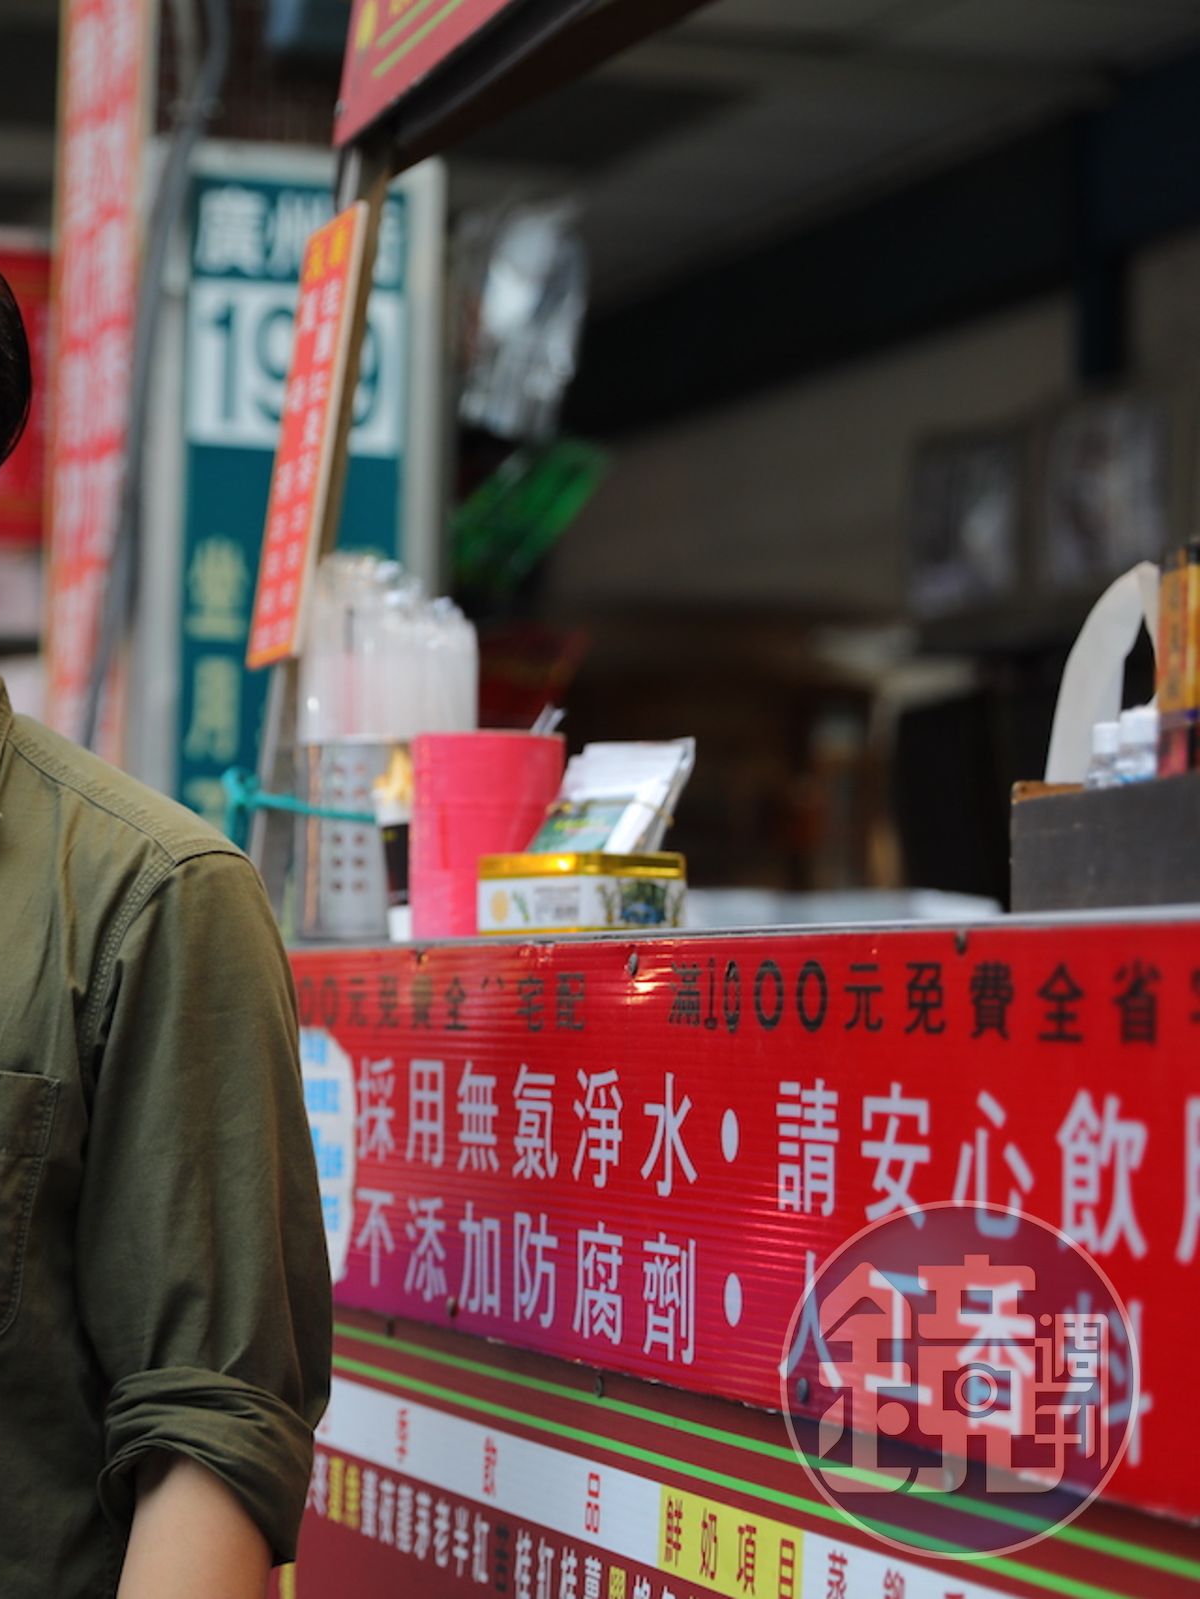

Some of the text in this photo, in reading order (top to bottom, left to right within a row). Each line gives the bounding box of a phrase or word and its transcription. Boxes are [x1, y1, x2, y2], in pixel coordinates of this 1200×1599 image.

[356, 1056, 1200, 1264] 採用無氯淨水•請安心飲
